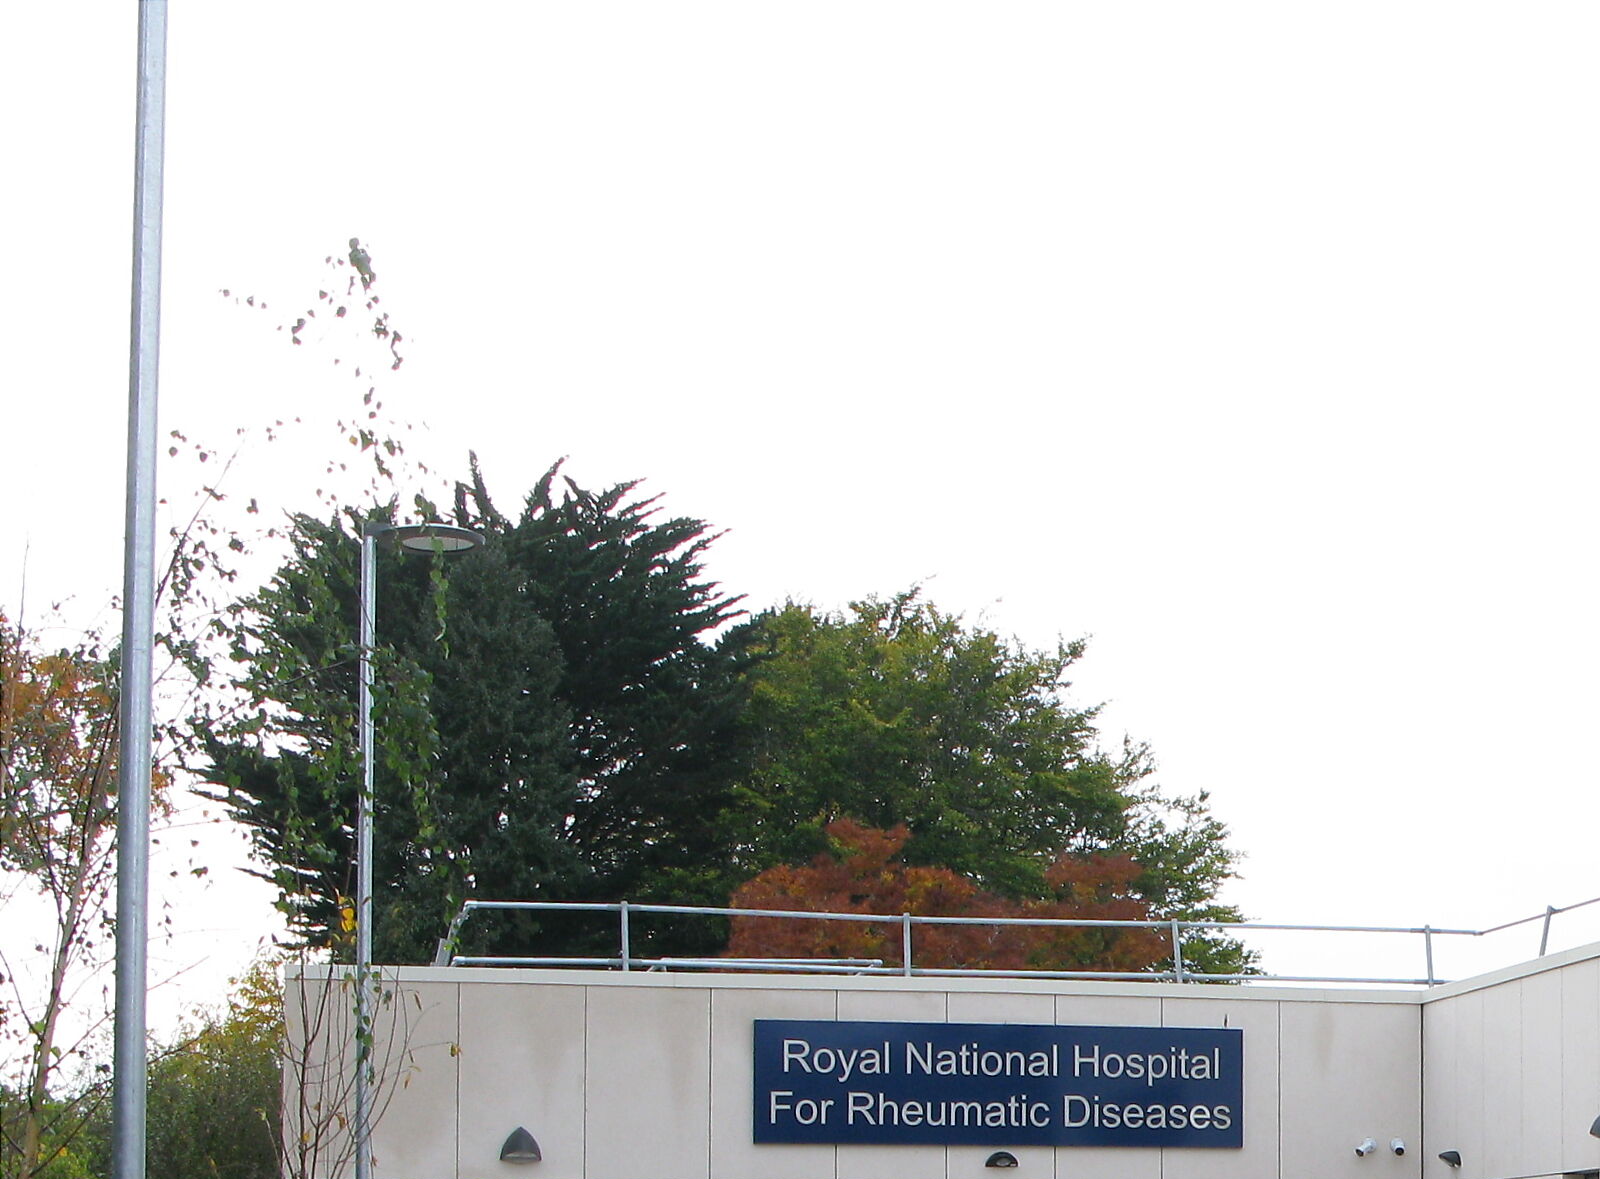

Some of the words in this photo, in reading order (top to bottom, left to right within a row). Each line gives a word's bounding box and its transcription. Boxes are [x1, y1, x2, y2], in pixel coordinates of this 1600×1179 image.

[782, 1039, 890, 1083] Royal
[905, 1042, 1058, 1077] National
[1073, 1044, 1220, 1087] Hospital
[769, 1091, 835, 1125] For
[847, 1091, 1050, 1128] Rheumatic
[1064, 1095, 1231, 1130] Diseases
